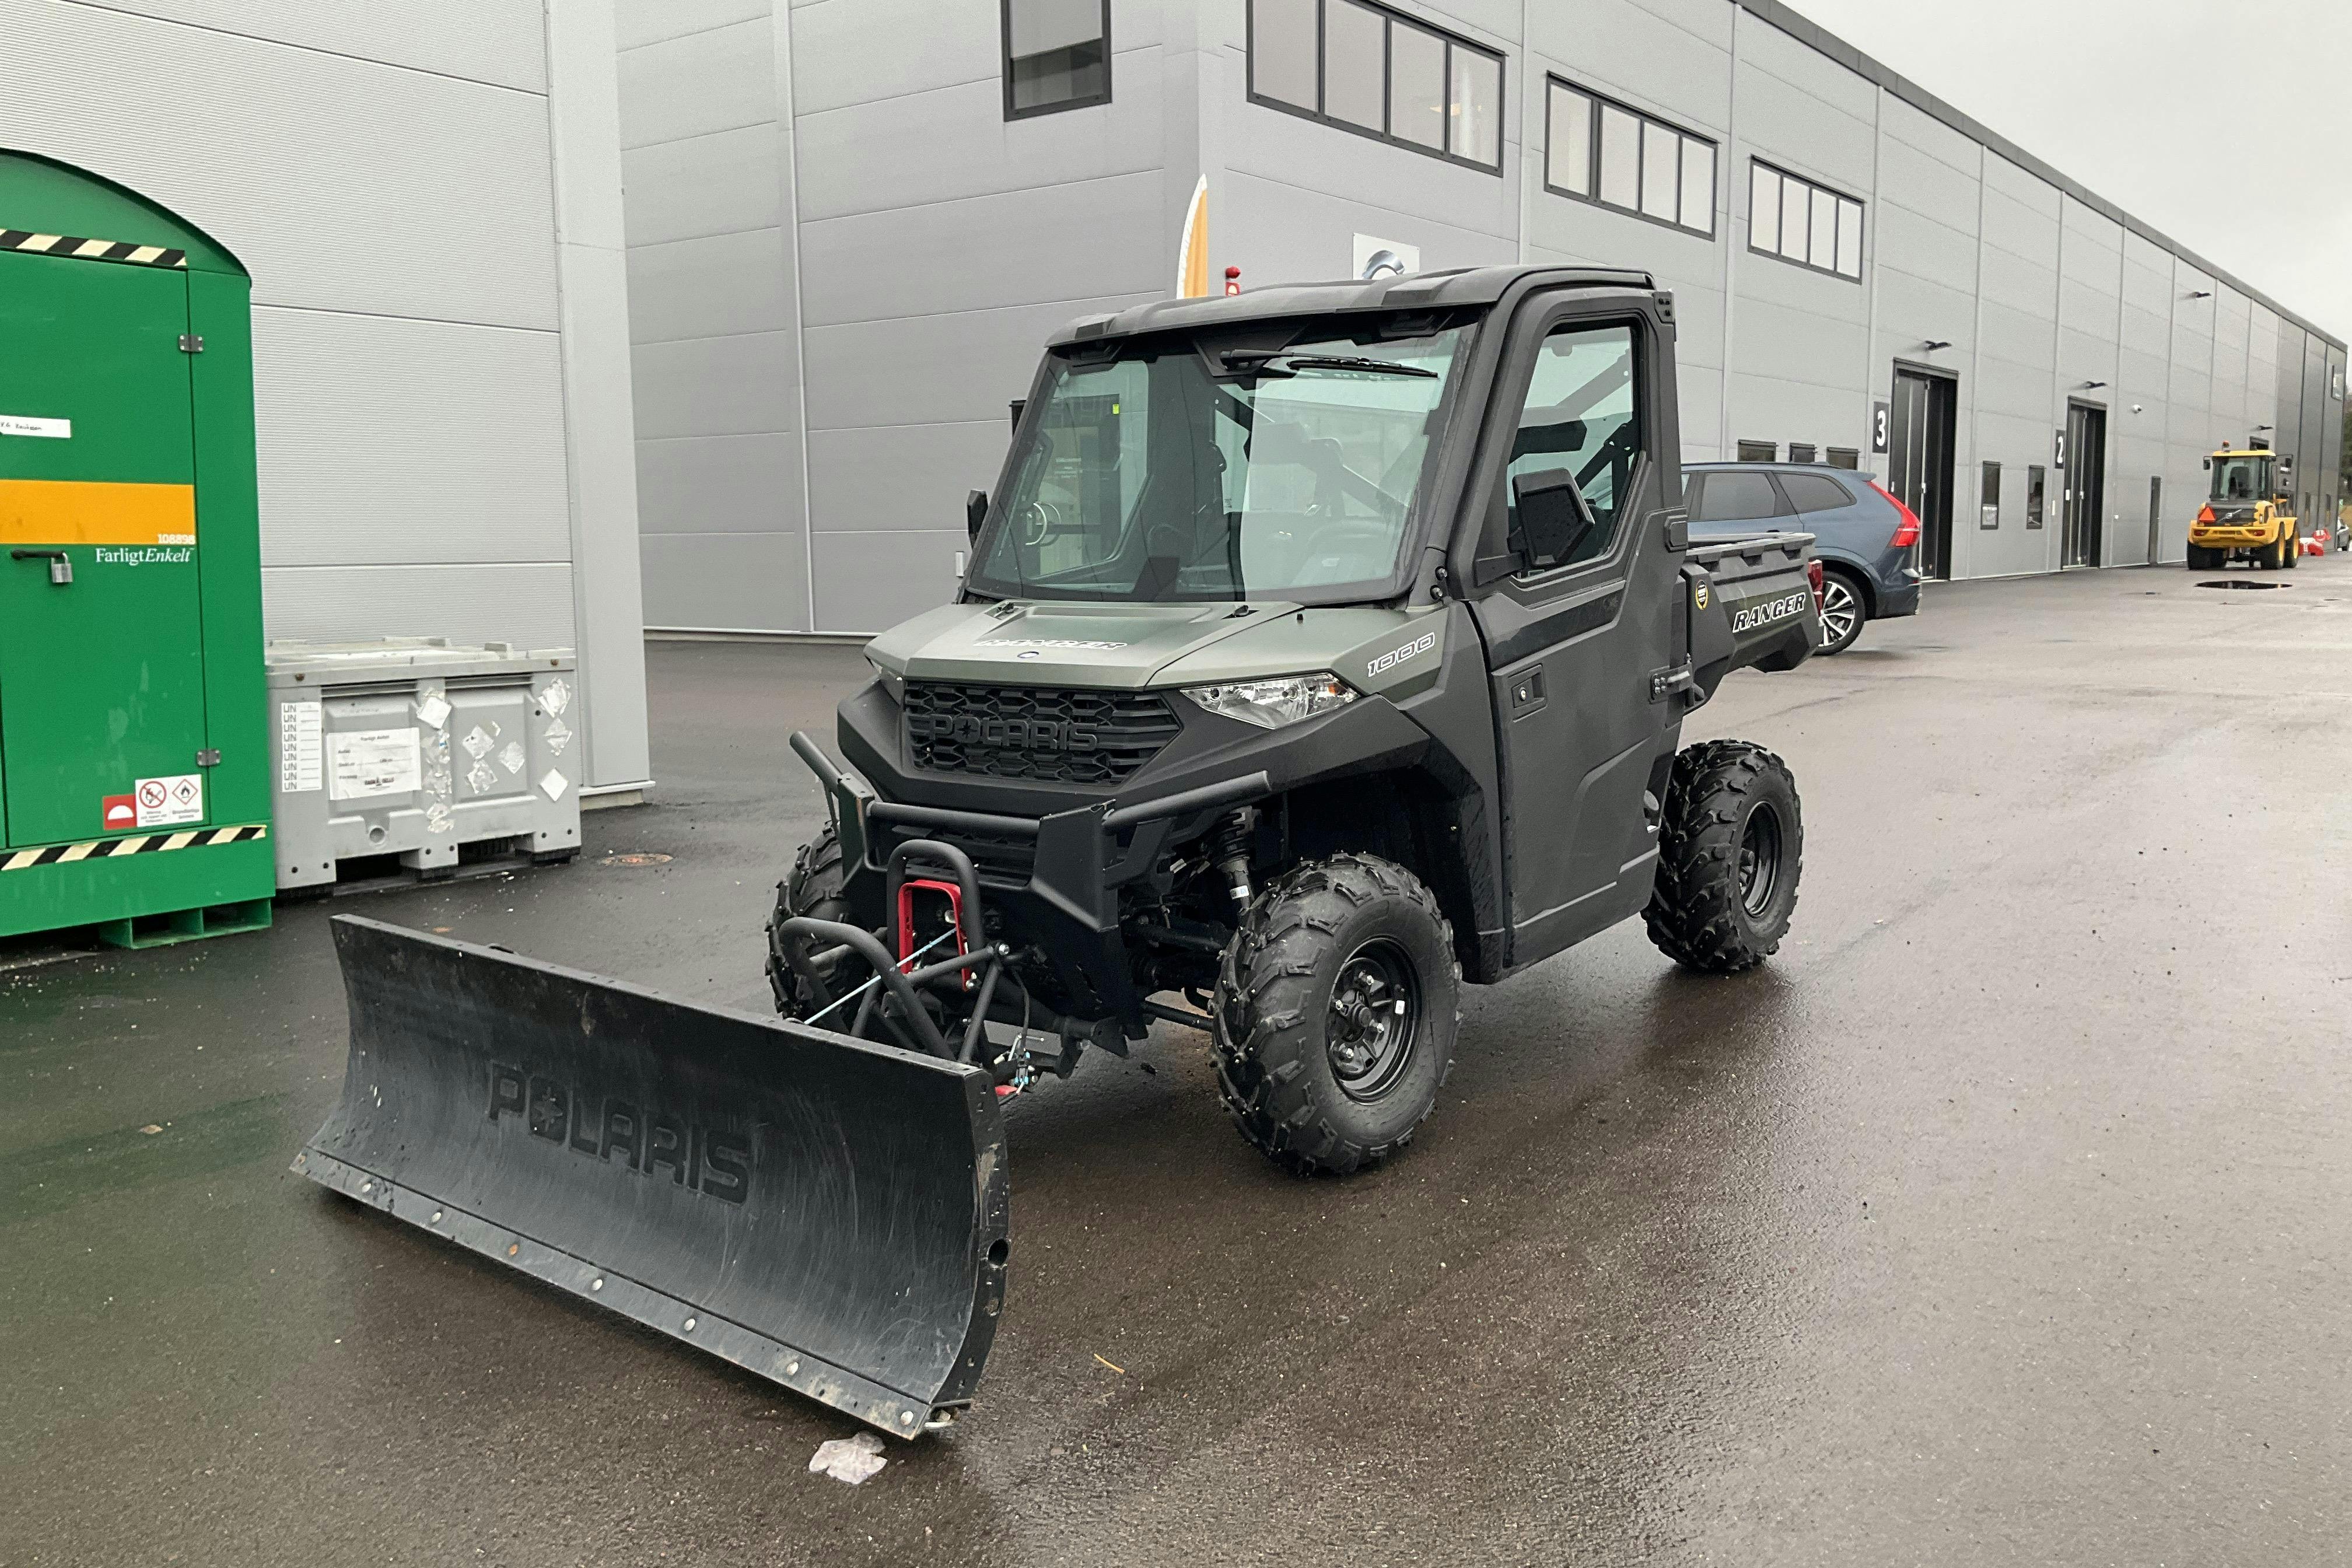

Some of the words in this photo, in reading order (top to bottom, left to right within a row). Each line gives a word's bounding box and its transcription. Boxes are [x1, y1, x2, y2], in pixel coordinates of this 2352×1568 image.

[1876, 410, 1886, 446] 3
[2057, 436, 2063, 464] 2
[1732, 592, 1805, 633] RANGER
[1367, 632, 1435, 677] 1000
[284, 704, 297, 713] UN
[284, 714, 297, 723] UN
[284, 724, 297, 732] UN
[930, 714, 1097, 751] POLARIS
[284, 733, 297, 742] UN
[284, 743, 297, 752] UN
[284, 752, 297, 761] UN
[284, 762, 297, 771] UN
[284, 772, 297, 780] UN
[284, 782, 297, 790] UN
[488, 1059, 753, 1205] POLARIS
